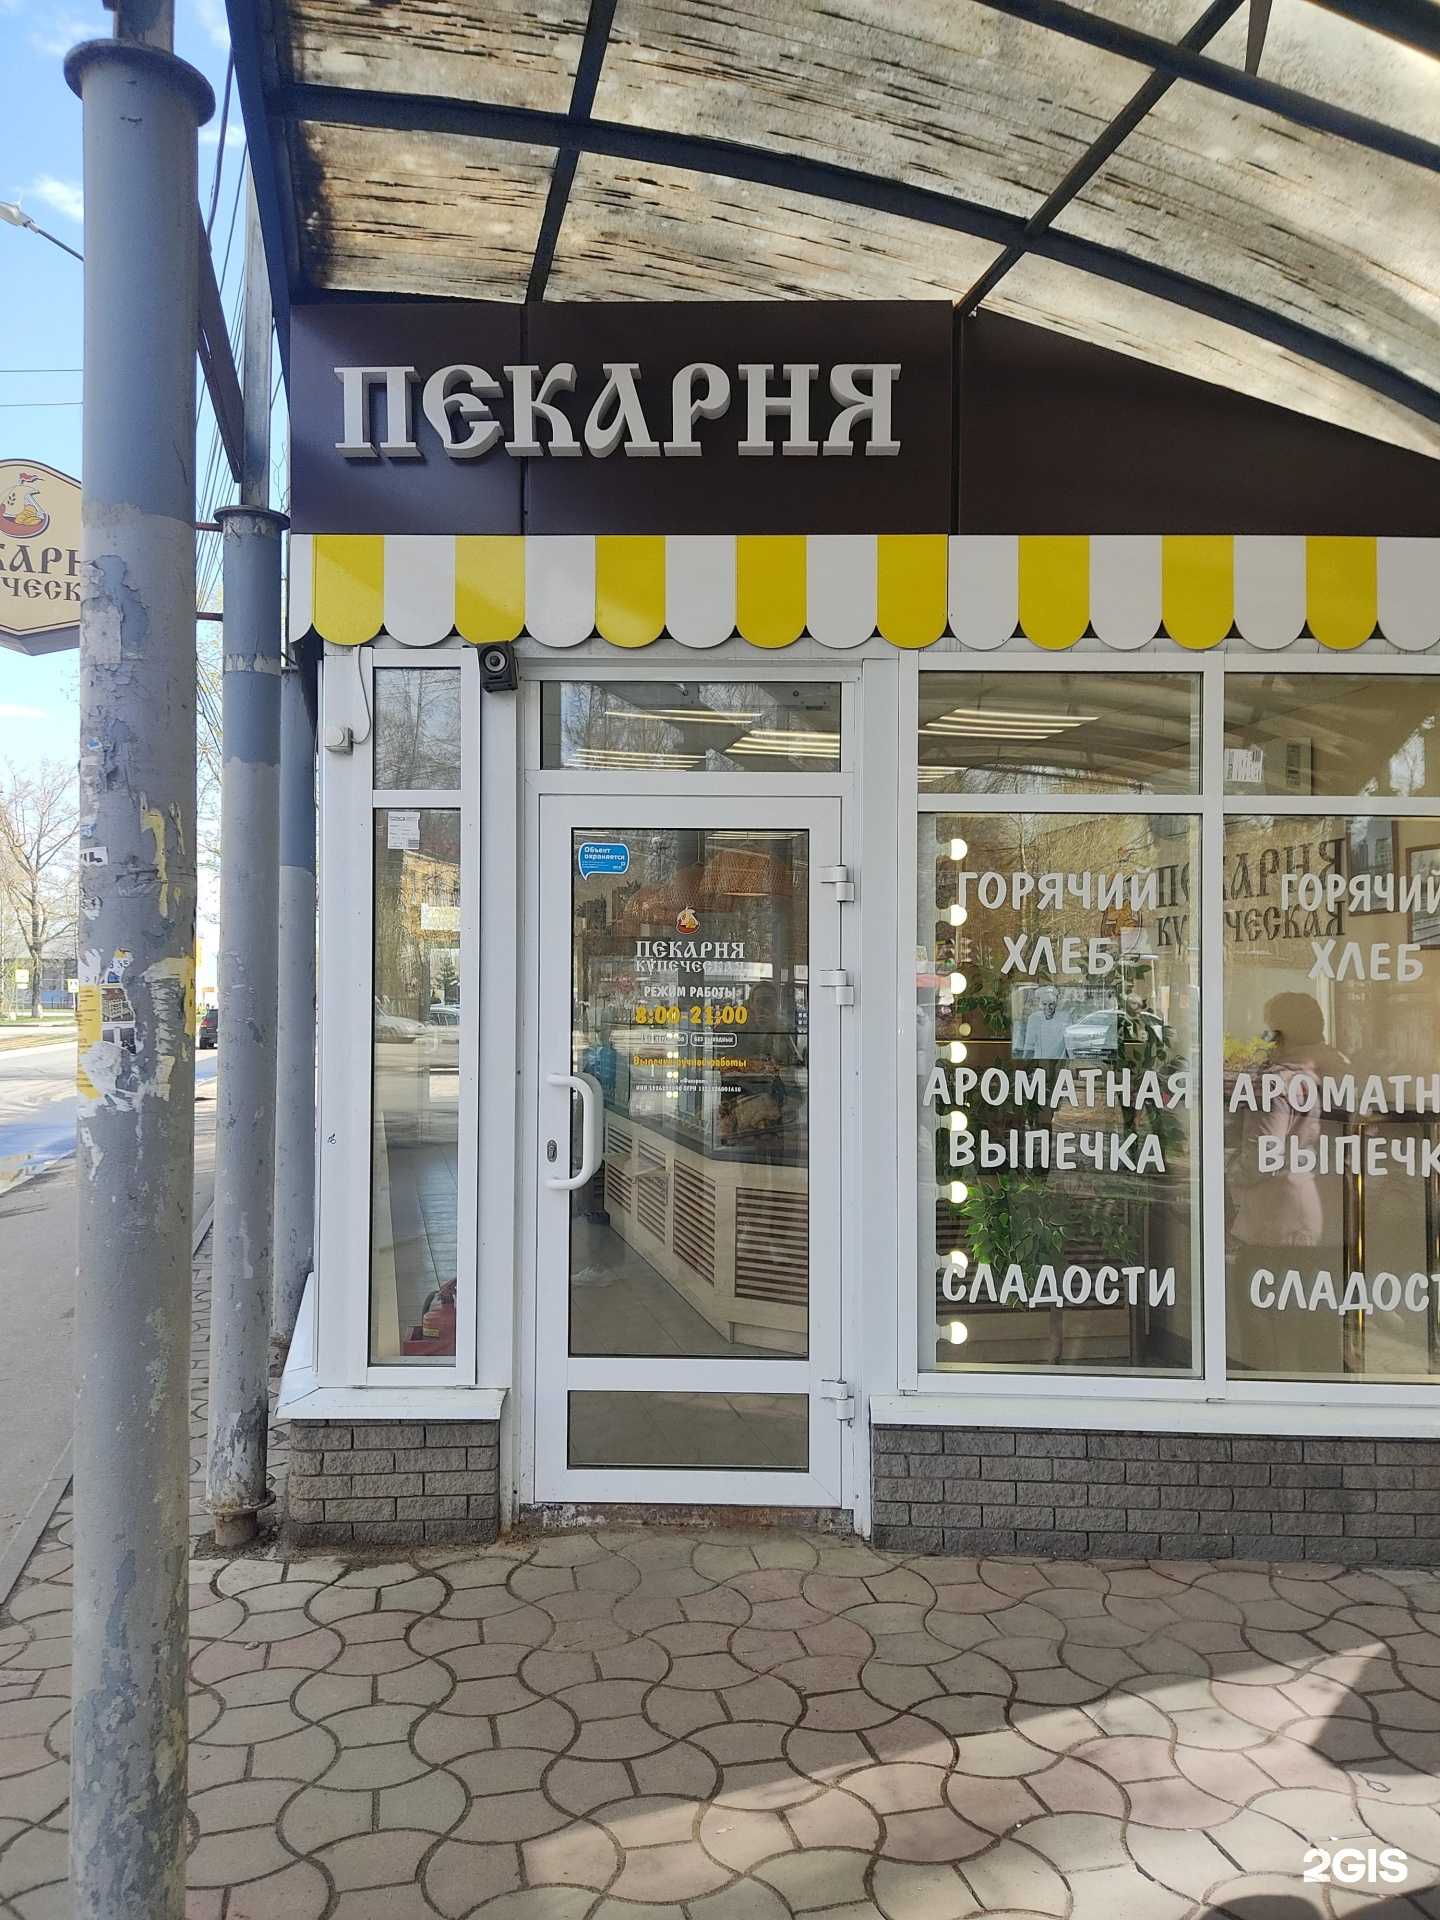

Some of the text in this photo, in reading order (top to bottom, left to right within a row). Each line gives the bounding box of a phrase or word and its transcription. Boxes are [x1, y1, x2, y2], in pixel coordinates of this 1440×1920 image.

[334, 362, 901, 458] ПЕКАРНЯ
[958, 868, 1157, 911] ГОРЯЧИЙ
[635, 940, 746, 959] ПЕКАРНЯ
[1001, 934, 1118, 975] ХЛЕБ
[1308, 939, 1424, 982] ХЛЕБ
[644, 986, 735, 999] РЕЖИМ РАБОТЫ
[923, 1067, 1192, 1110] АРОМАТНАЯ
[950, 1129, 1165, 1173] ВЫПЕЧКА
[942, 1264, 1175, 1308] СЛАДОСТИ
